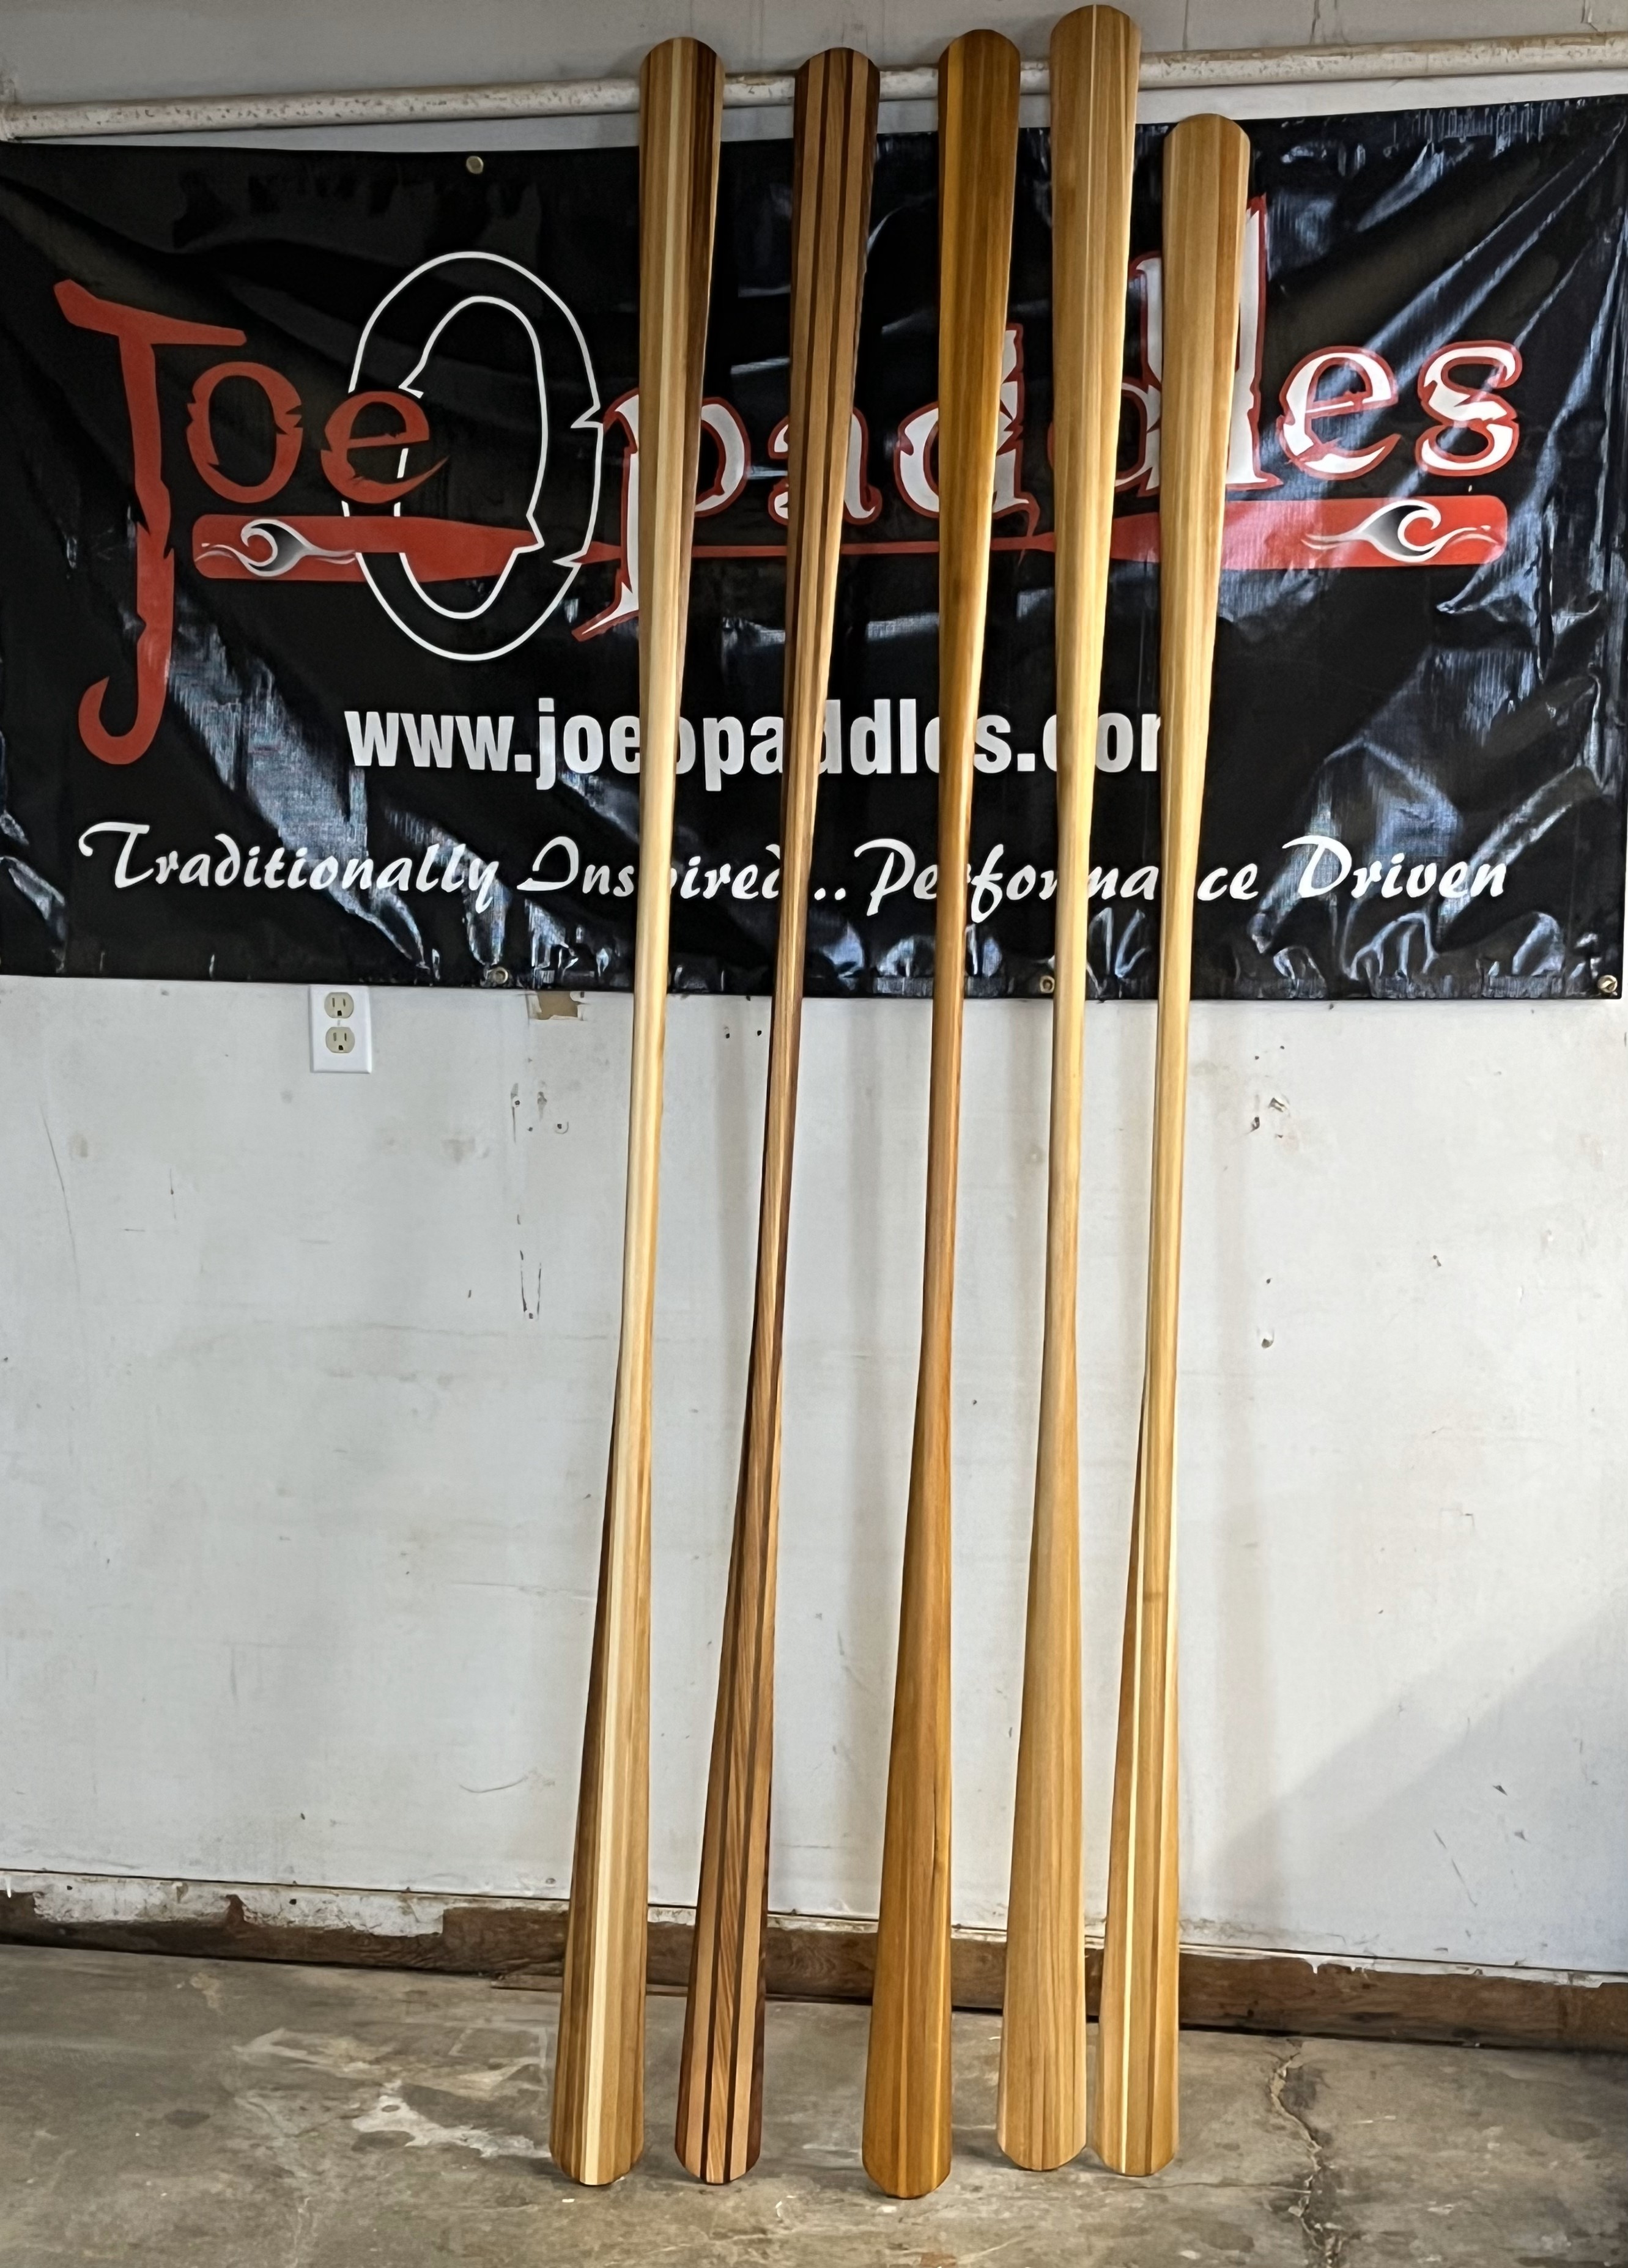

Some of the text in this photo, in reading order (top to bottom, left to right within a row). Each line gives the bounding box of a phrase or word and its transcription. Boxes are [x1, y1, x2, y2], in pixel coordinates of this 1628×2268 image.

[53, 279, 449, 764] Joe
[344, 697, 1161, 791] www.joepaddls.o
[78, 821, 1507, 923] Traditionally Insired.. Peformace Driven
